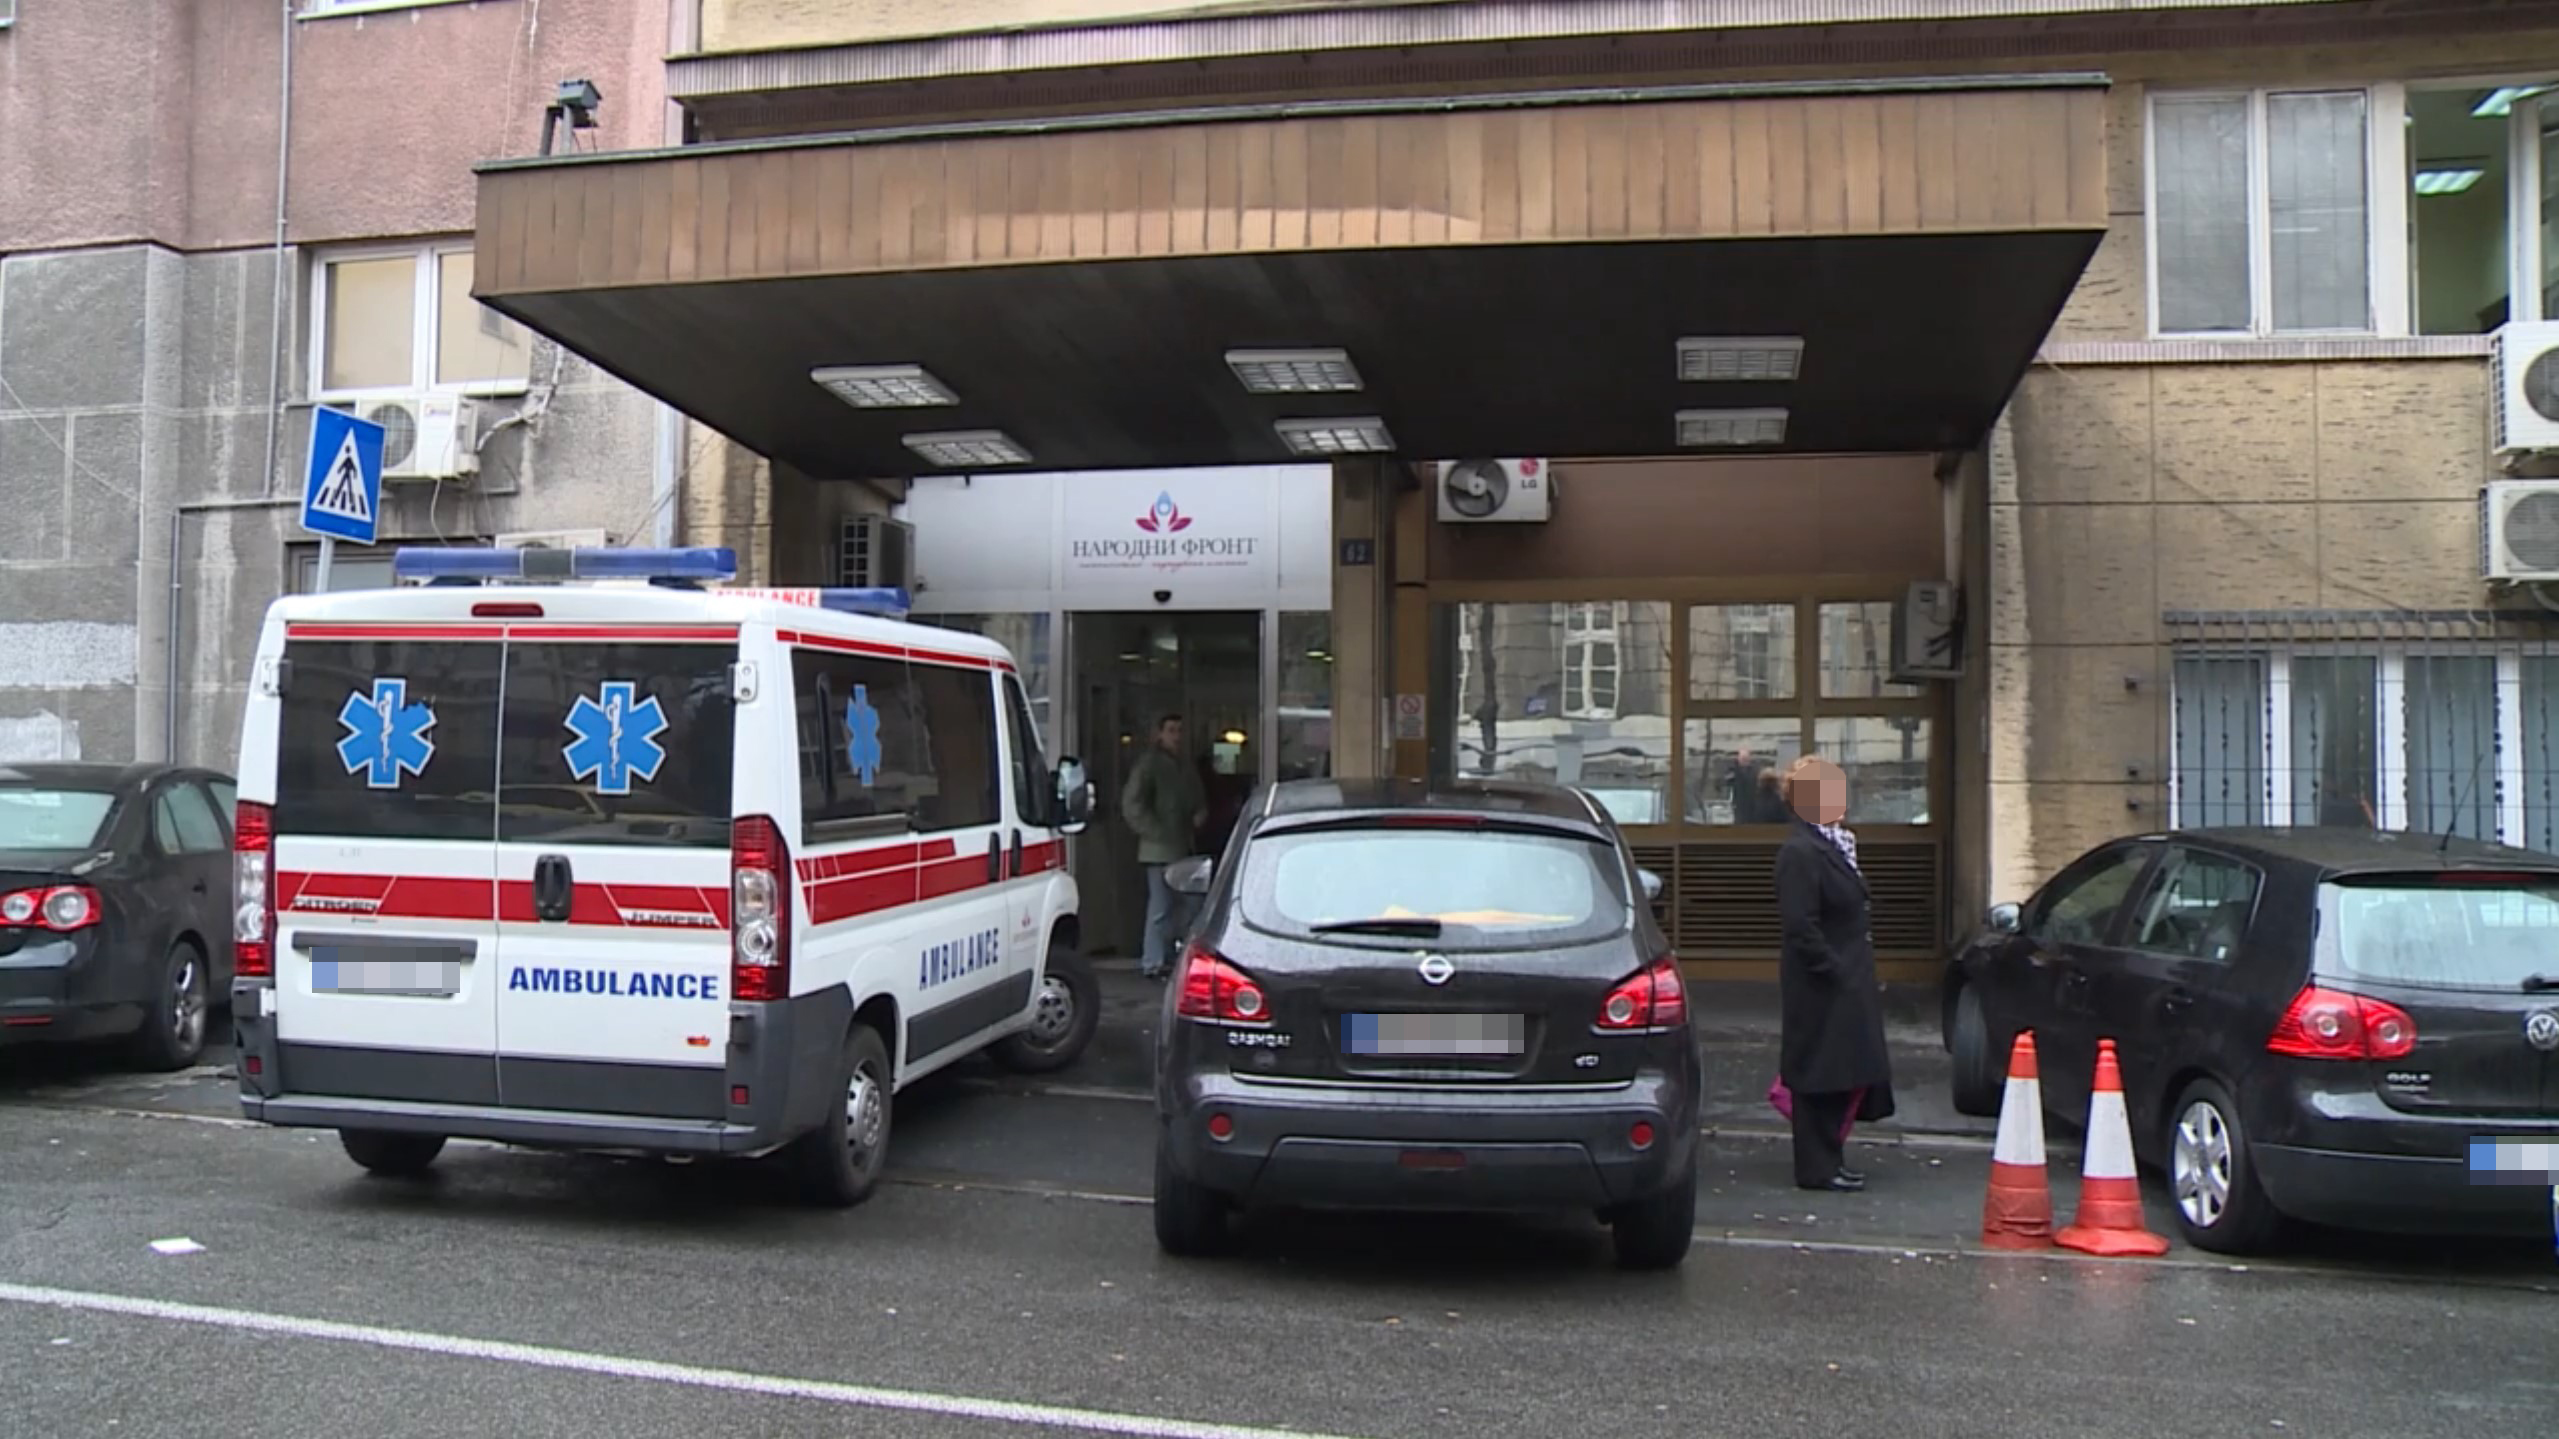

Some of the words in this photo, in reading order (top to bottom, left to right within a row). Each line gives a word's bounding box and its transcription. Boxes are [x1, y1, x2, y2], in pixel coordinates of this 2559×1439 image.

[1521, 479, 1538, 489] LG
[1073, 538, 1177, 560] НАРОДНИ
[1181, 536, 1258, 558] ФРОНТ
[623, 911, 714, 926] JUMPER
[919, 927, 999, 992] AMBULANCE
[509, 966, 719, 1001] AMBULANCE
[2386, 1072, 2431, 1083] GOLF
